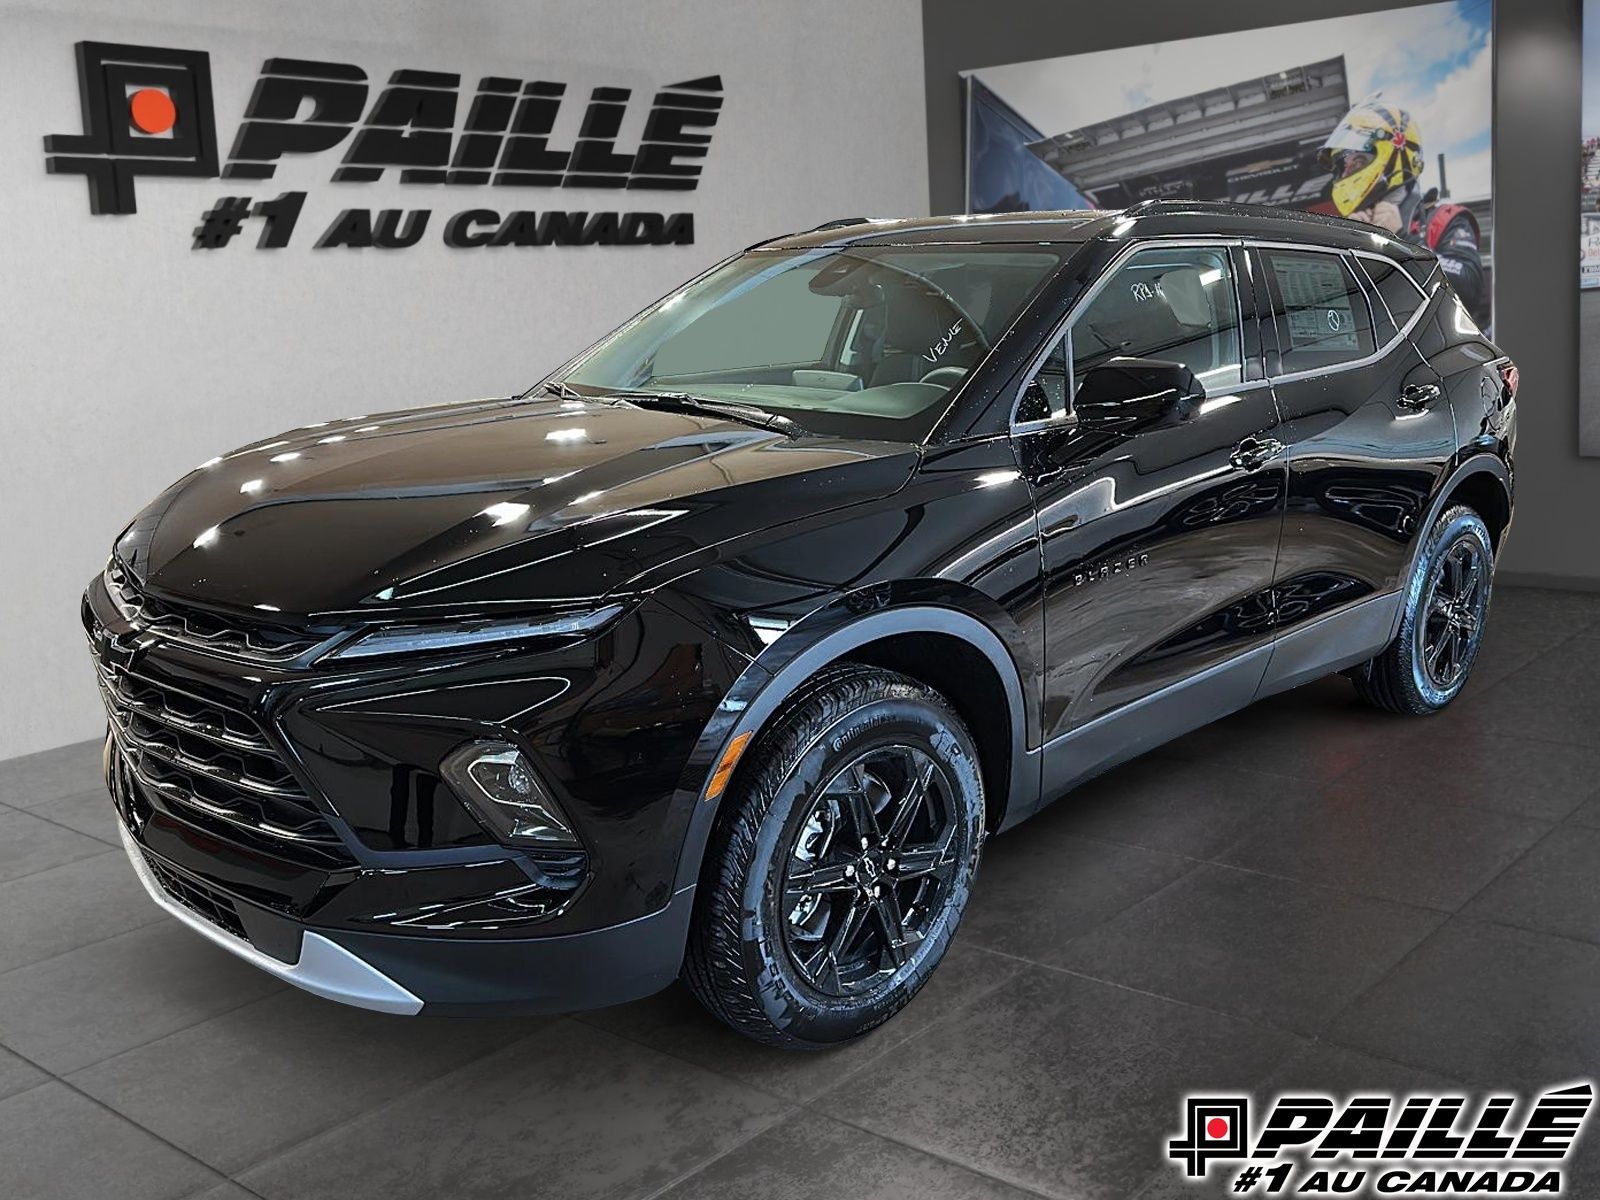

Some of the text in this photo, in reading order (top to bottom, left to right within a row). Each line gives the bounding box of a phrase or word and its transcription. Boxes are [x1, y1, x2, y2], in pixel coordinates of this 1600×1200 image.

[220, 57, 724, 191] PAILLÉ
[1227, 163, 1299, 183] CHEVROLET
[192, 191, 695, 250] #1 AU CANADA
[1075, 553, 1148, 586] BLAZER
